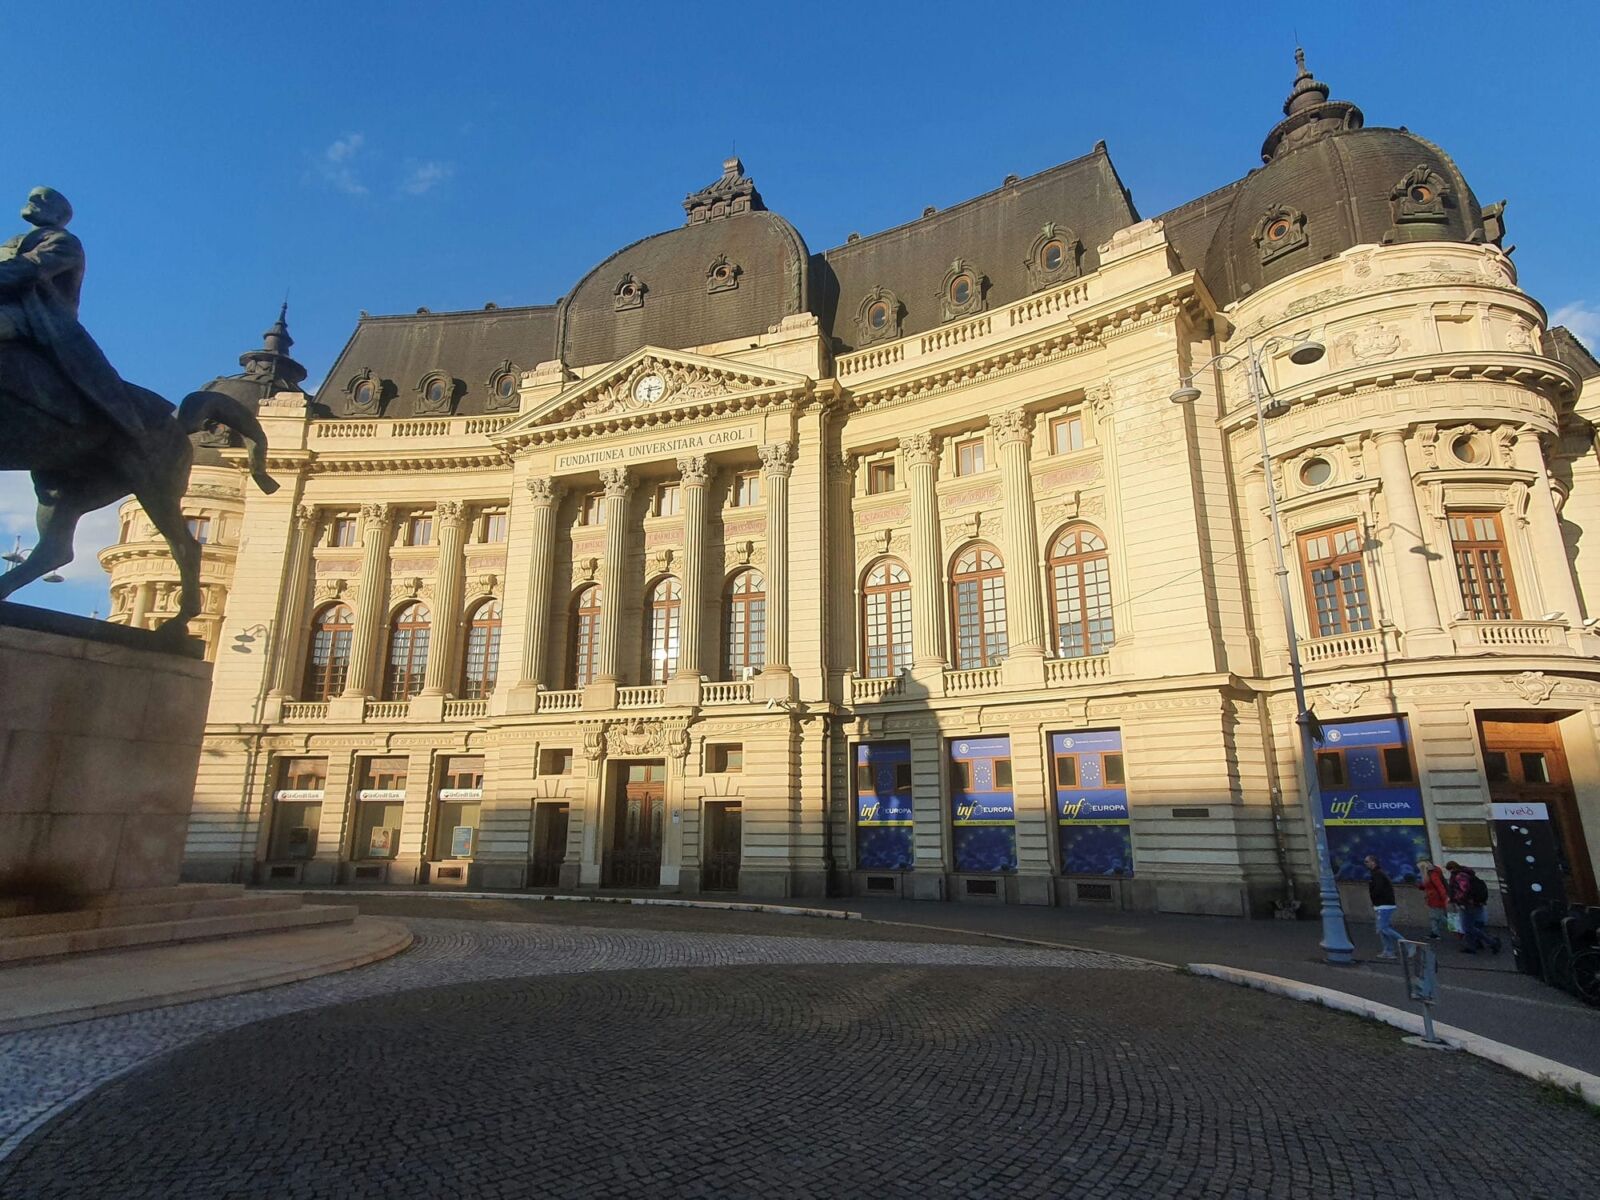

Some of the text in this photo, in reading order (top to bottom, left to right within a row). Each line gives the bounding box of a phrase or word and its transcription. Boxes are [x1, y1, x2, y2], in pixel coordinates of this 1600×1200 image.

[560, 427, 753, 468] FUNDATIUNEA UNIVERSITARA CAROL I
[1092, 804, 1126, 812] EUROPA
[1367, 802, 1411, 810] EUROPA
